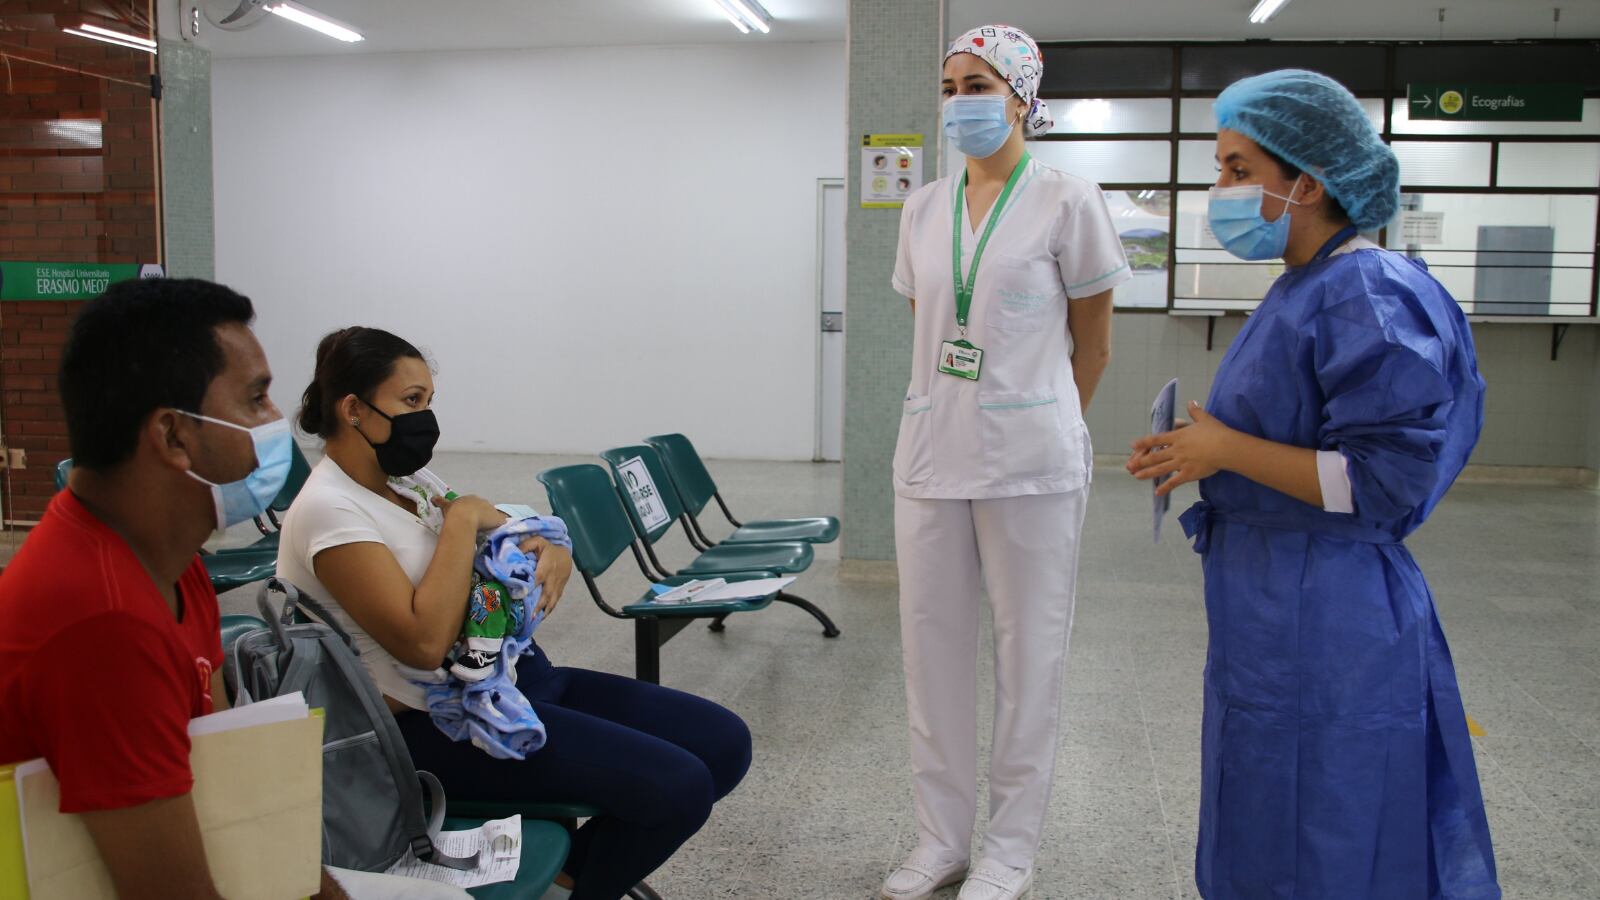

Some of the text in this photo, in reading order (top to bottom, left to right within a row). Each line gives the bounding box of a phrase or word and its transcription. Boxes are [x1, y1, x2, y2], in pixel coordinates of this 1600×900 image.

[52, 268, 75, 279] Hospital
[76, 269, 110, 279] Universitario
[37, 278, 80, 294] ERASMO
